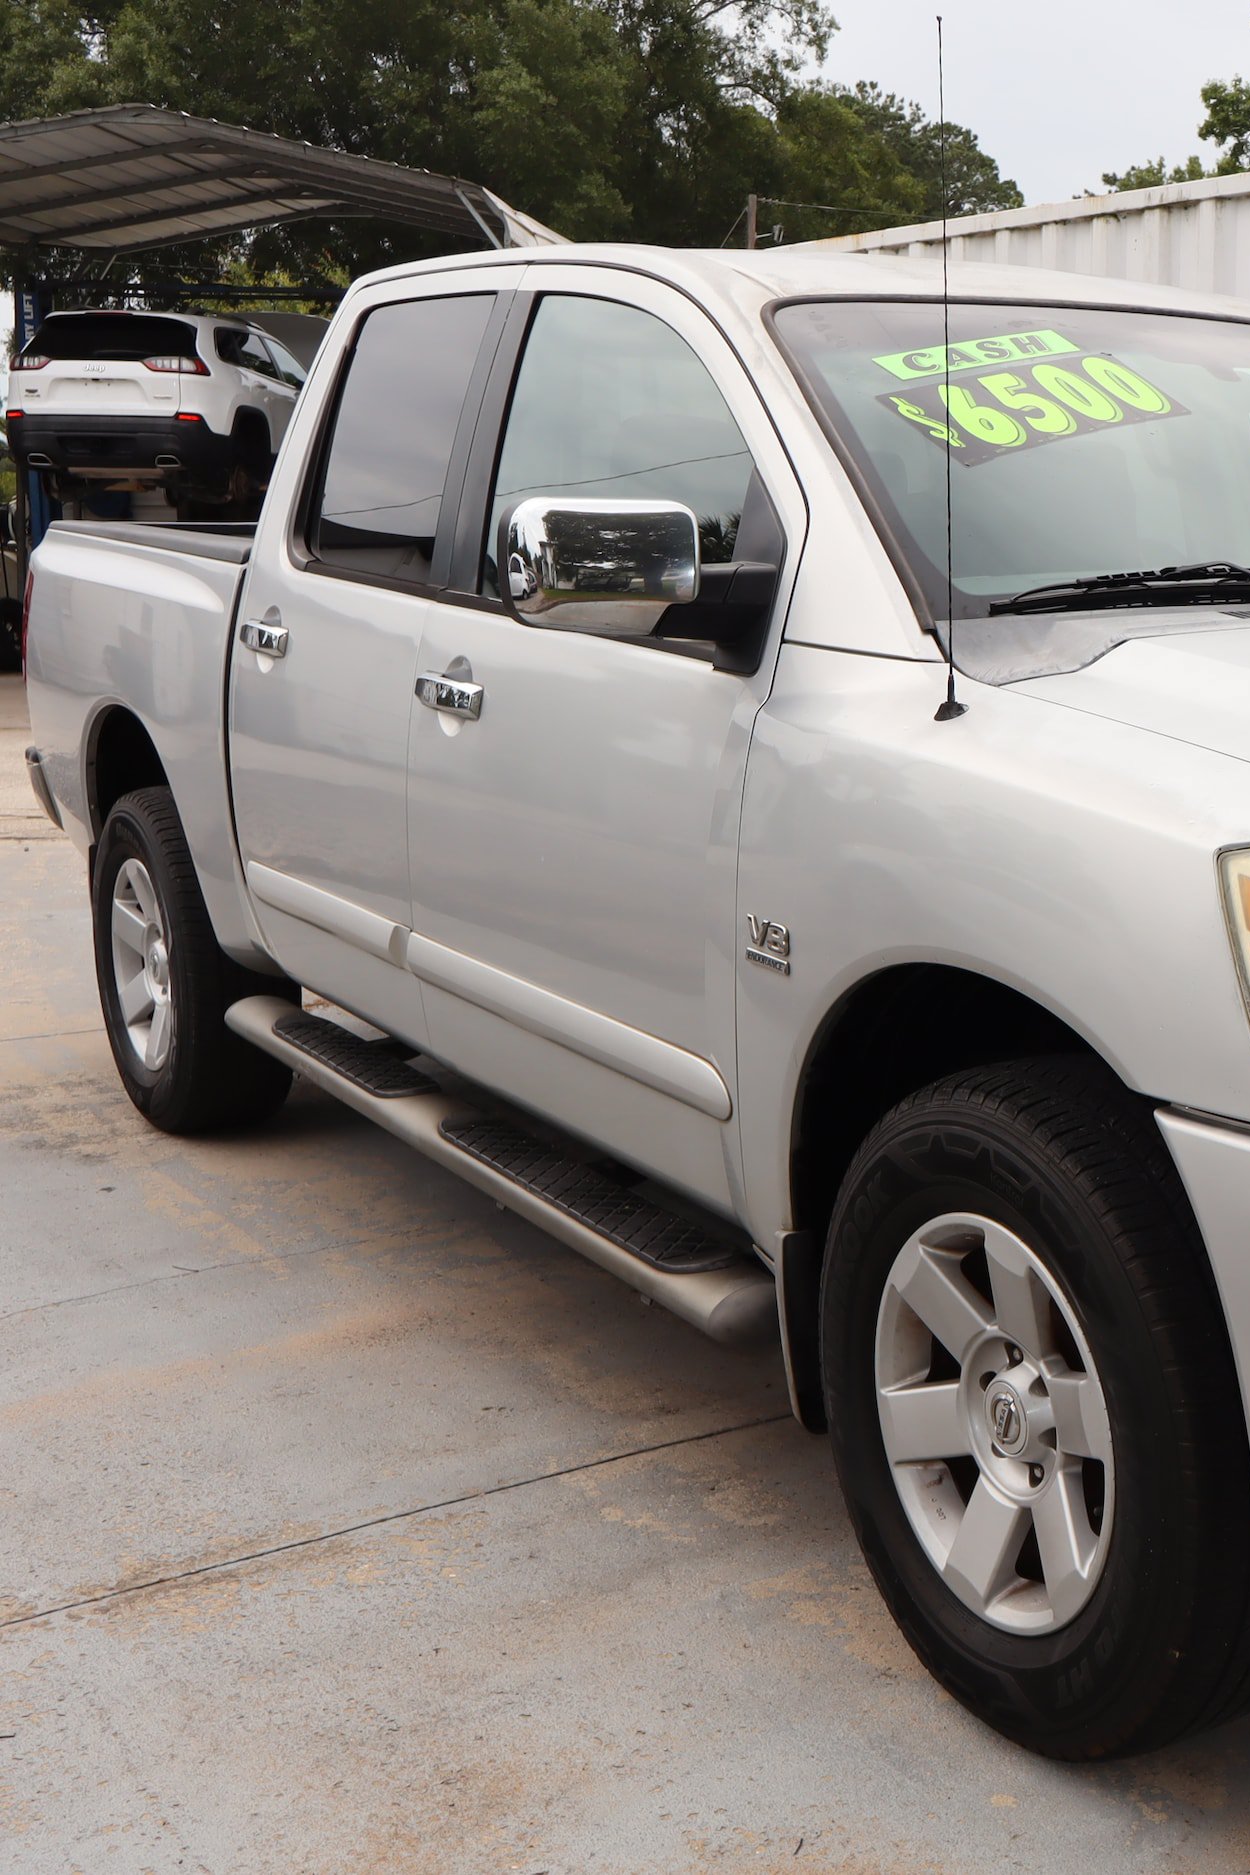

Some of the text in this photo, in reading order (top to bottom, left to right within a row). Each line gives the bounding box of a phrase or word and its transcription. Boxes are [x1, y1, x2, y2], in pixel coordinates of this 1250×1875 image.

[23, 293, 34, 319] LIFT
[83, 363, 105, 374] Jeep
[901, 335, 1051, 373] CASH
[889, 356, 1171, 448] $6500
[747, 913, 790, 956] V8
[746, 950, 784, 972] ENDURANCE
